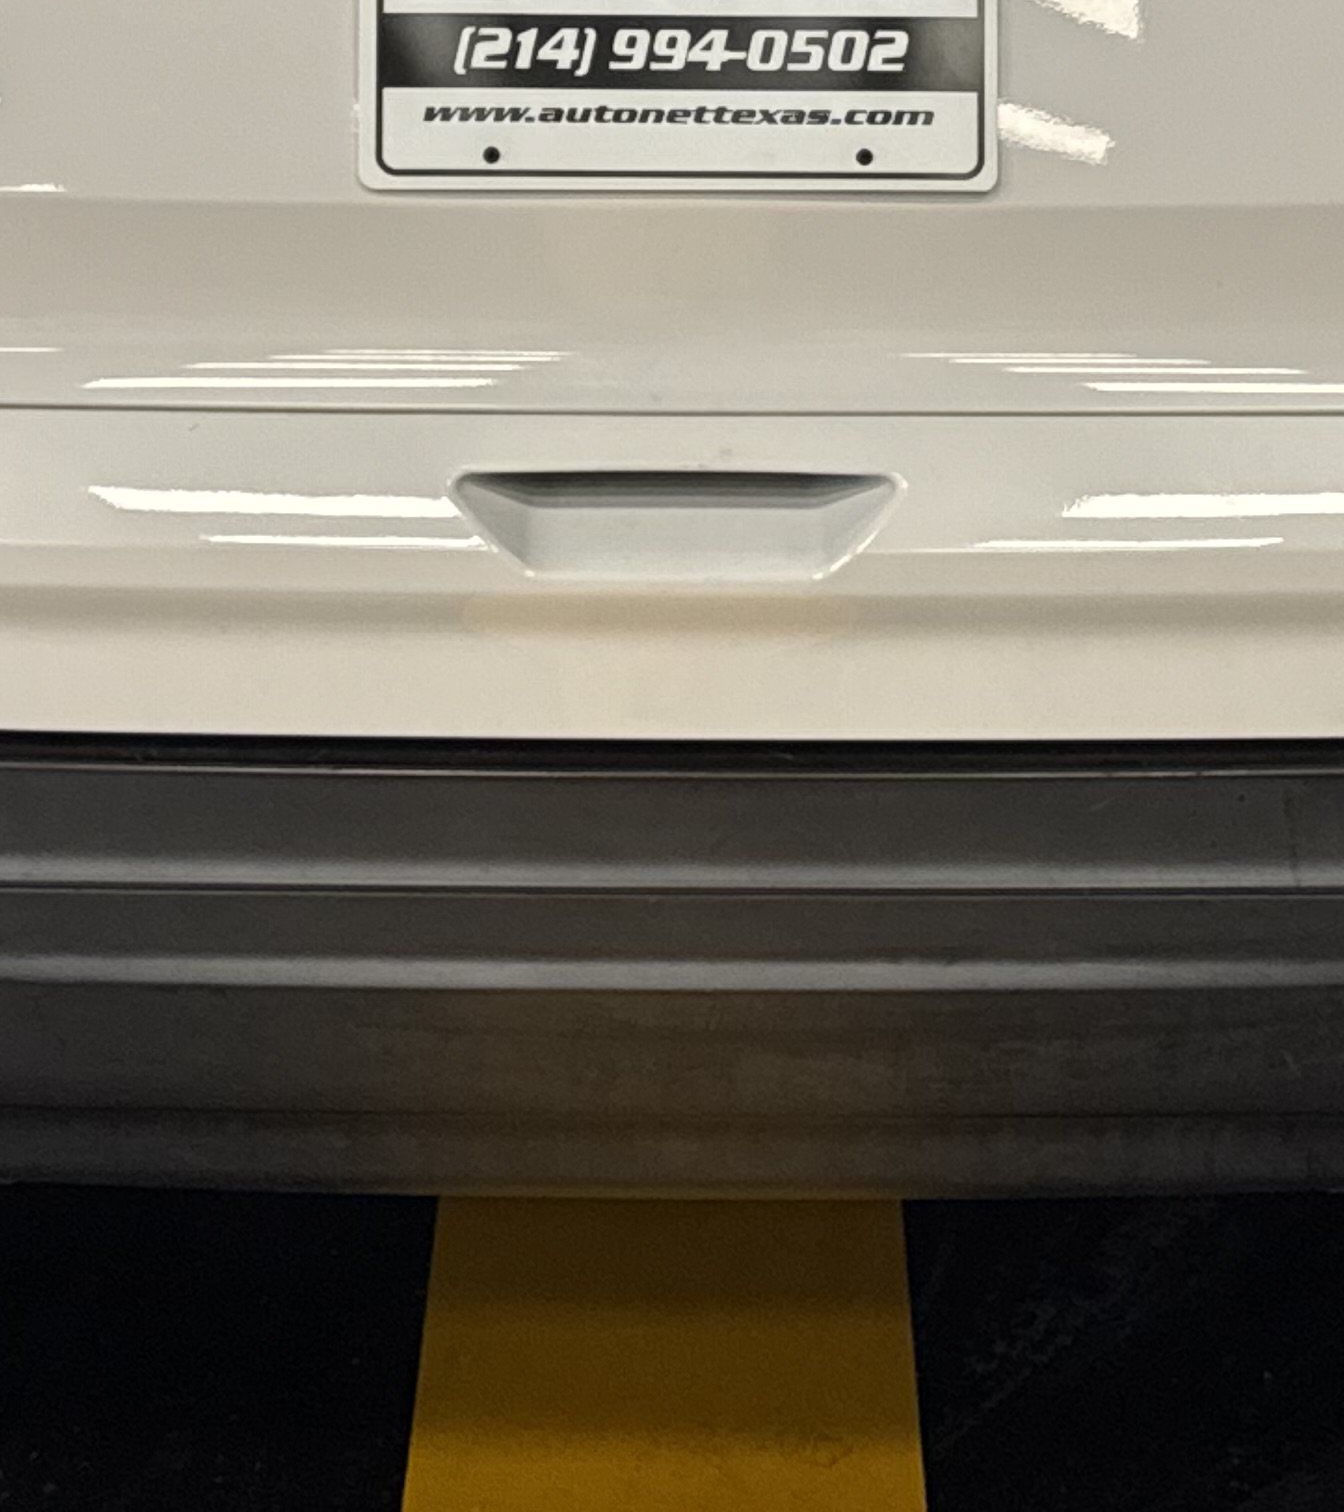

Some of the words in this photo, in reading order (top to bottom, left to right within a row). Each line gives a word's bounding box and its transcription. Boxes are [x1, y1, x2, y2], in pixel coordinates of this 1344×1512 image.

[454, 25, 597, 76] (214)
[607, 28, 909, 73] 994-0502
[422, 104, 934, 126] www.autonettexas.com
